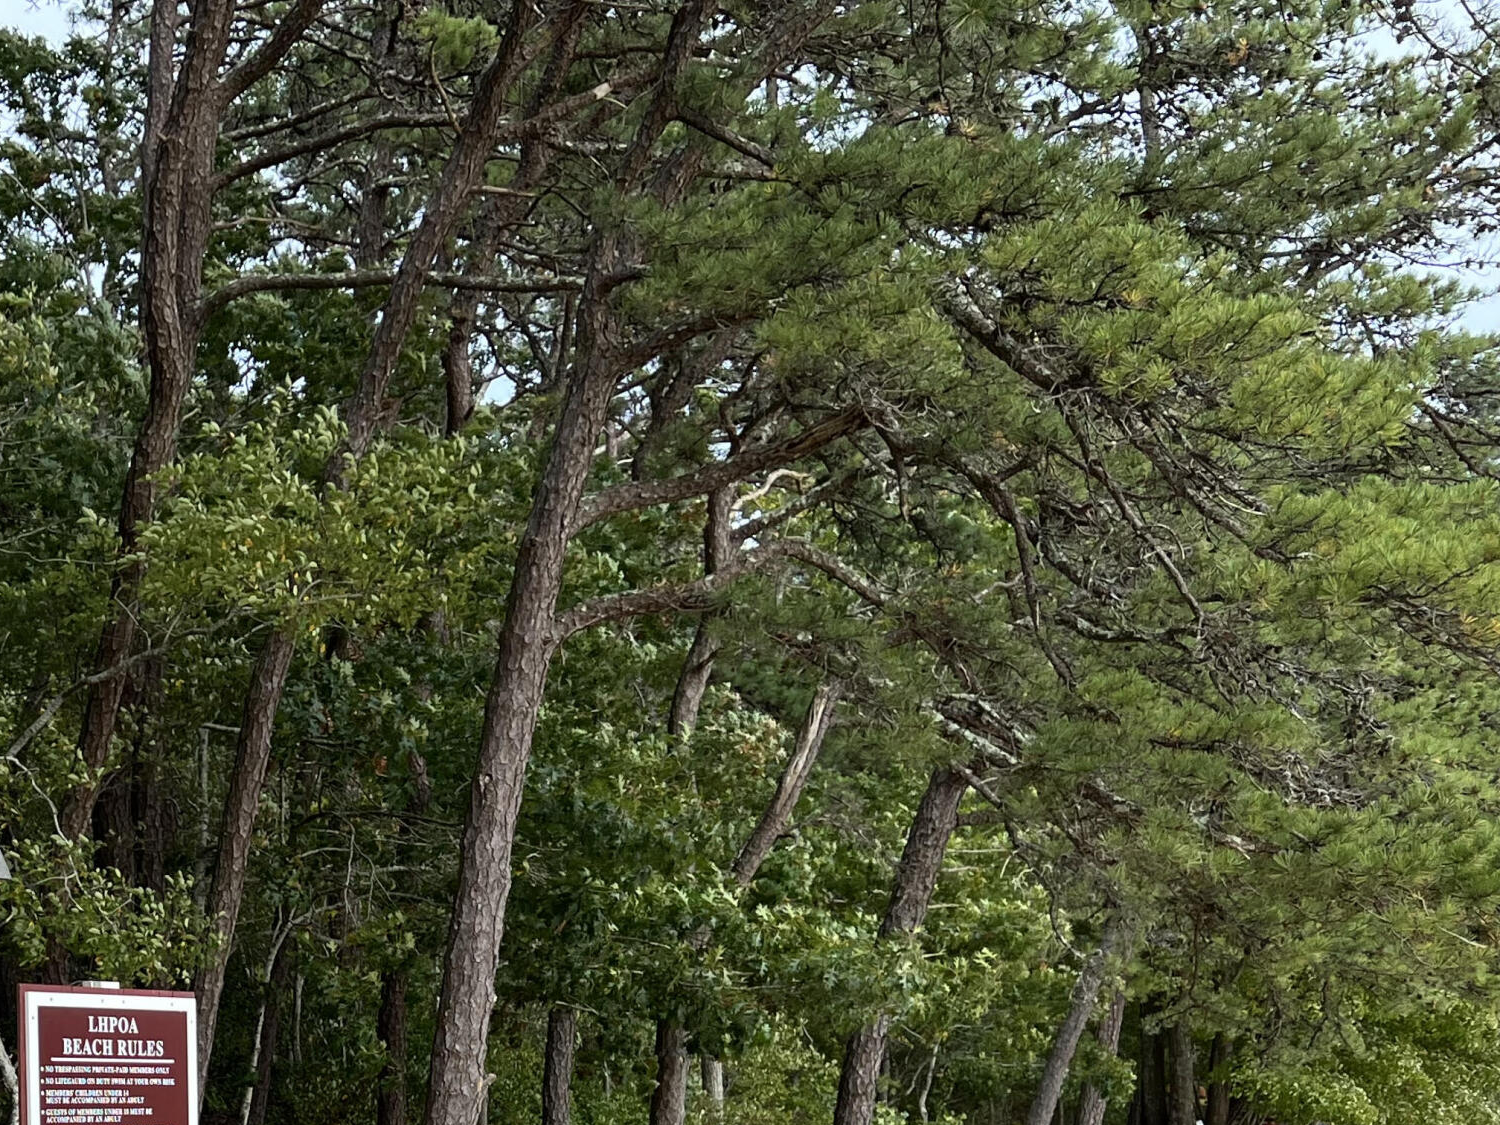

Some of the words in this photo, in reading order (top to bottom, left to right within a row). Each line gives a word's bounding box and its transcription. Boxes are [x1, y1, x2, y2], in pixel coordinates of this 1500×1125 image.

[88, 1015, 139, 1034] LHPOA
[62, 1038, 113, 1056] BEACH
[117, 1039, 164, 1057] RULES
[129, 1066, 155, 1074] MEMBERS
[155, 1066, 170, 1074] ONLY
[45, 1077, 54, 1085] NO
[87, 1077, 95, 1085] ON
[96, 1077, 111, 1085] DUTY
[46, 1096, 62, 1104] MUST
[62, 1096, 70, 1104] BE
[71, 1096, 111, 1104] ACCOMPANIED
[111, 1096, 119, 1104] BY
[119, 1096, 127, 1104] AN
[127, 1096, 145, 1104] ADULT
[45, 1108, 67, 1116] GUESTS
[77, 1108, 104, 1116] MEMBERS
